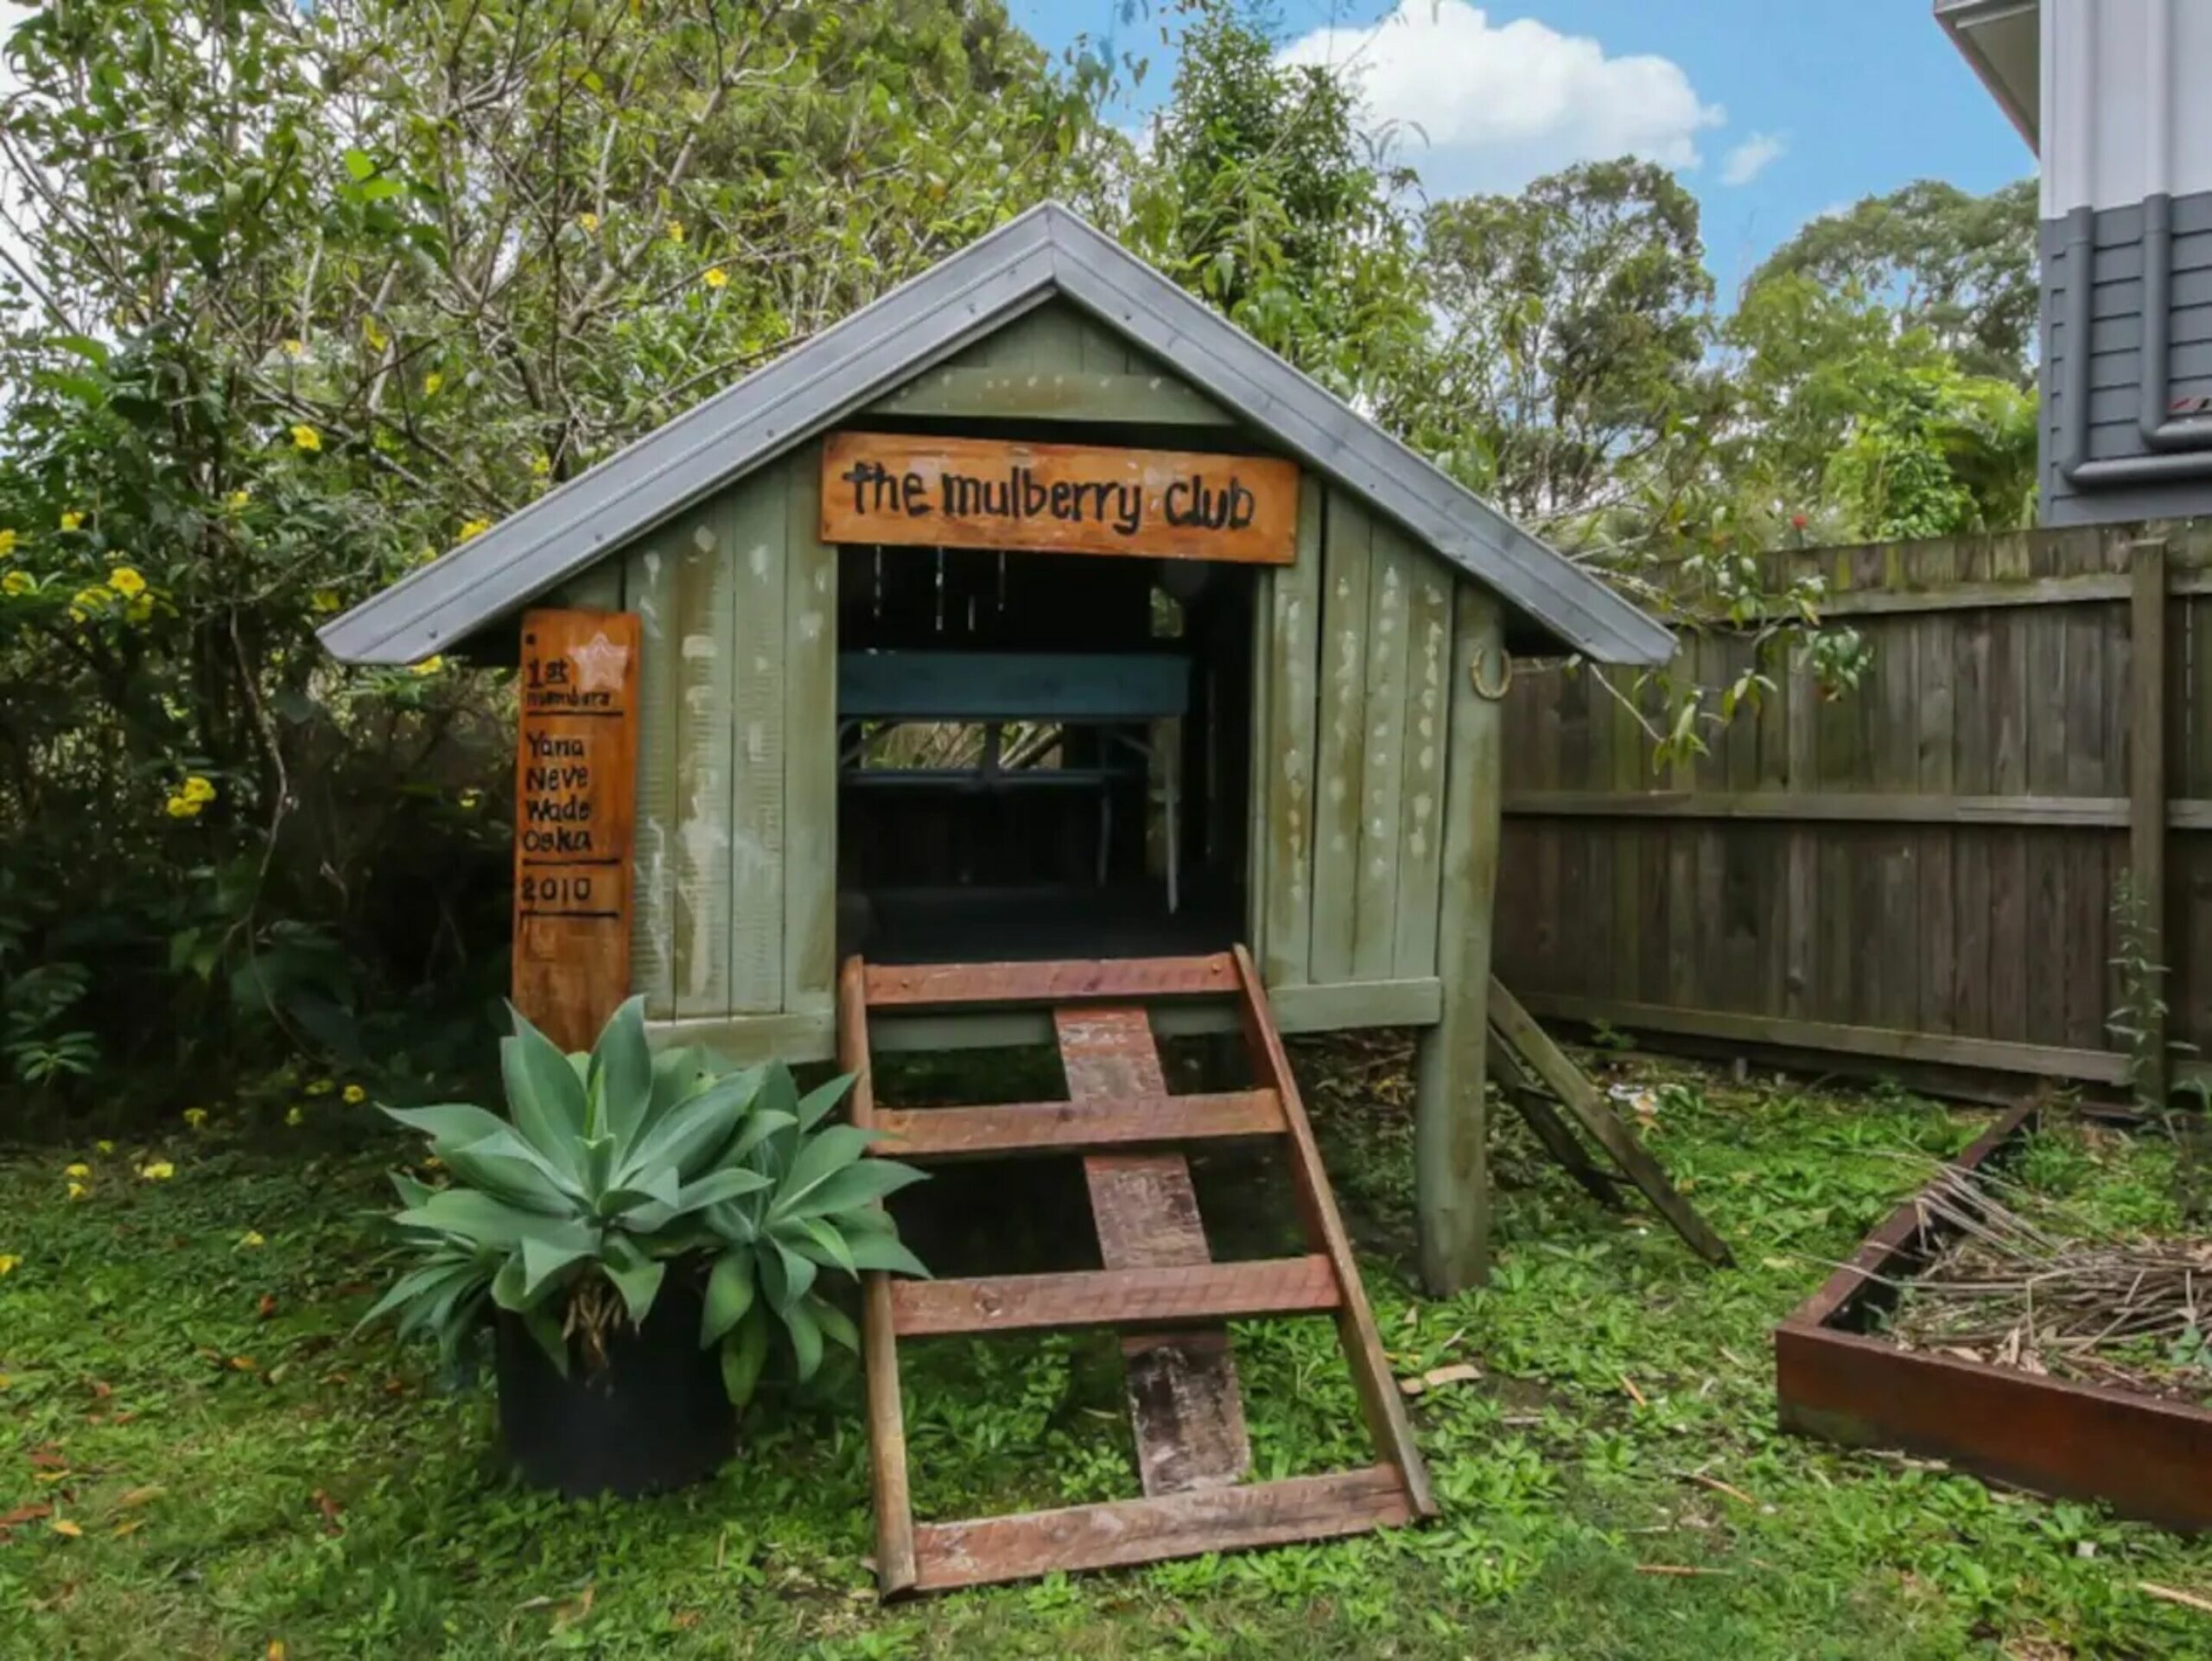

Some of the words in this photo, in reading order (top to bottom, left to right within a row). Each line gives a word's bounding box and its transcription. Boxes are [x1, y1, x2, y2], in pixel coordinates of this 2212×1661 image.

[842, 461, 932, 515] the
[940, 466, 1141, 535] mulberry
[1164, 475, 1255, 530] club
[527, 658, 569, 688] 1st
[526, 731, 585, 758] Yana
[525, 765, 588, 792] Neve
[525, 795, 591, 822] Wade
[522, 876, 591, 902] 2010
